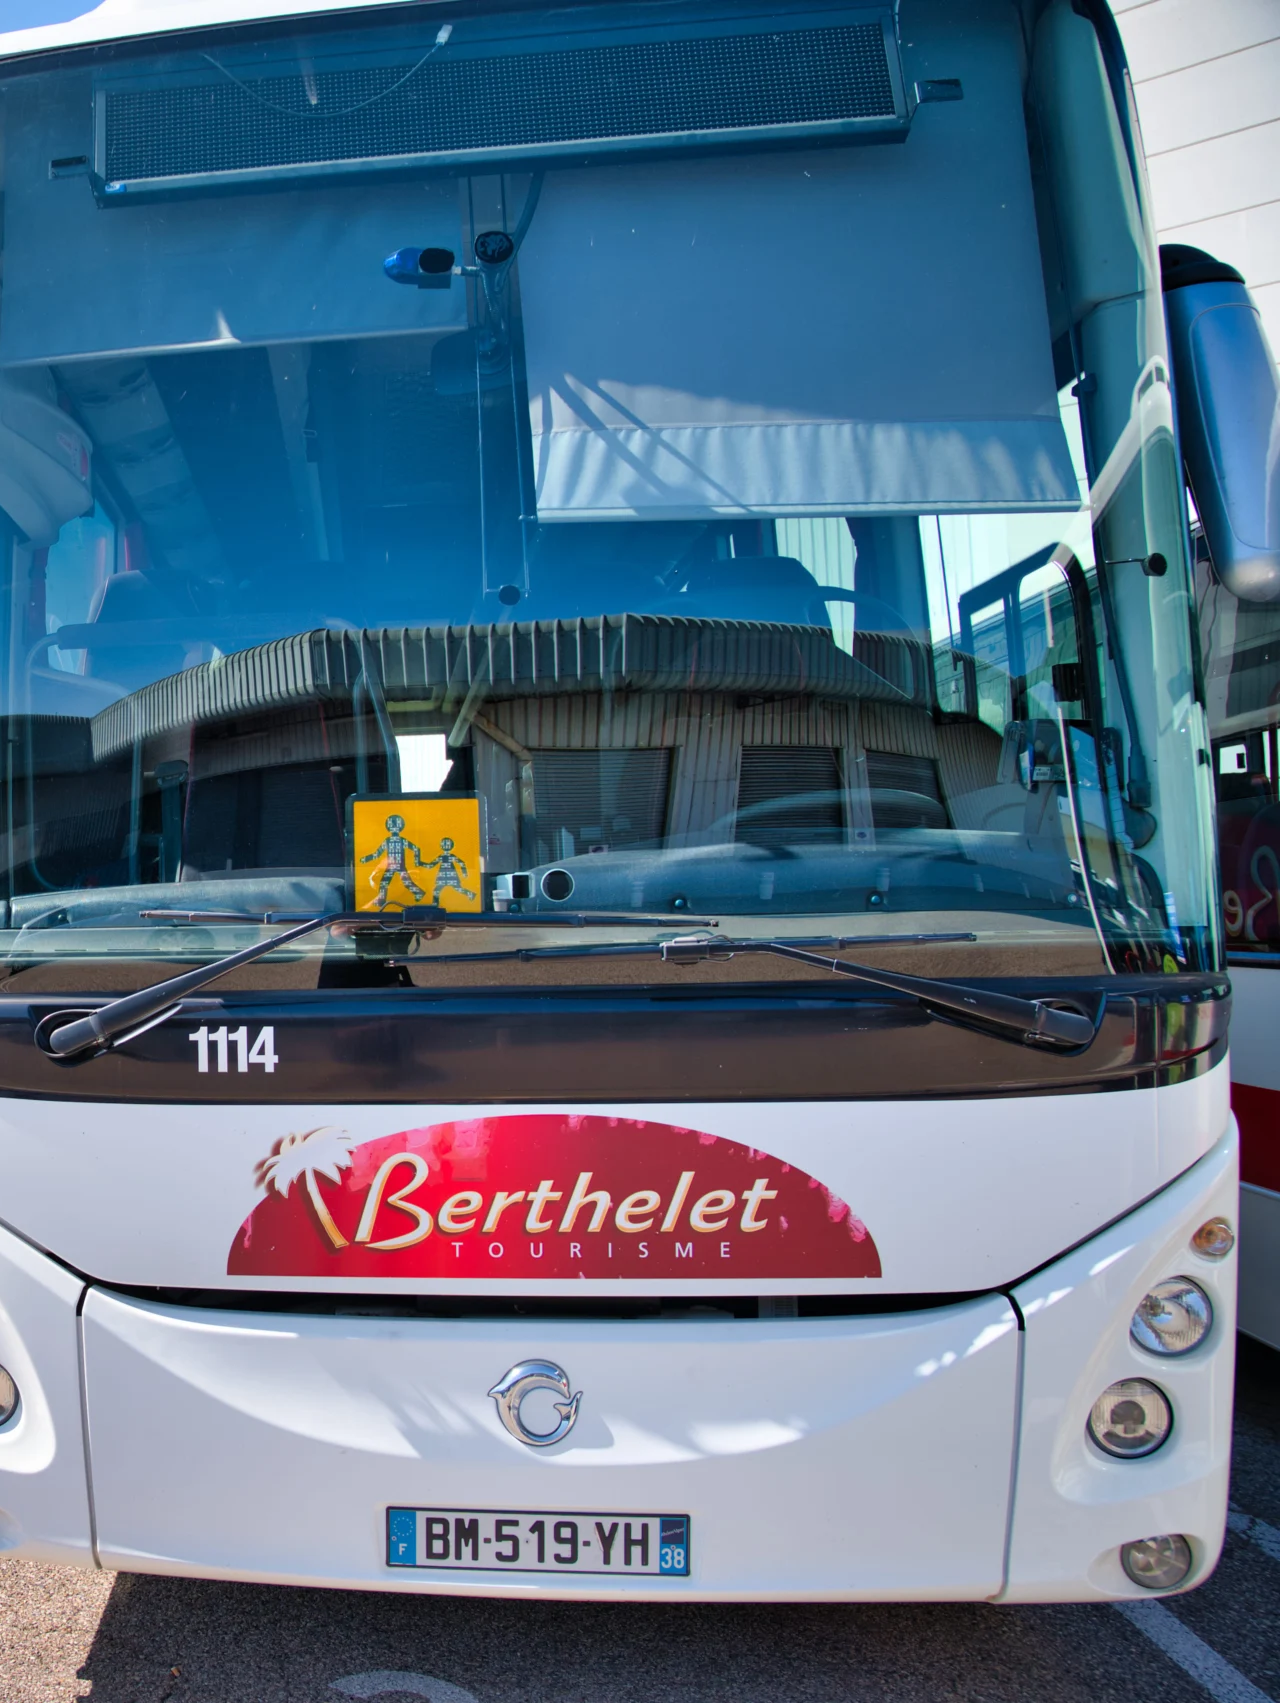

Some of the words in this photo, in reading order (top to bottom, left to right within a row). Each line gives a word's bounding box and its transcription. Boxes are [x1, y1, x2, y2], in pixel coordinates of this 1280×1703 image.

[189, 1025, 280, 1074] 1114
[356, 1151, 778, 1251] Berthelet
[450, 1241, 732, 1258] TOURISME
[398, 1543, 408, 1556] F
[425, 1516, 650, 1566] BM-519-YH
[660, 1547, 685, 1569] 38
